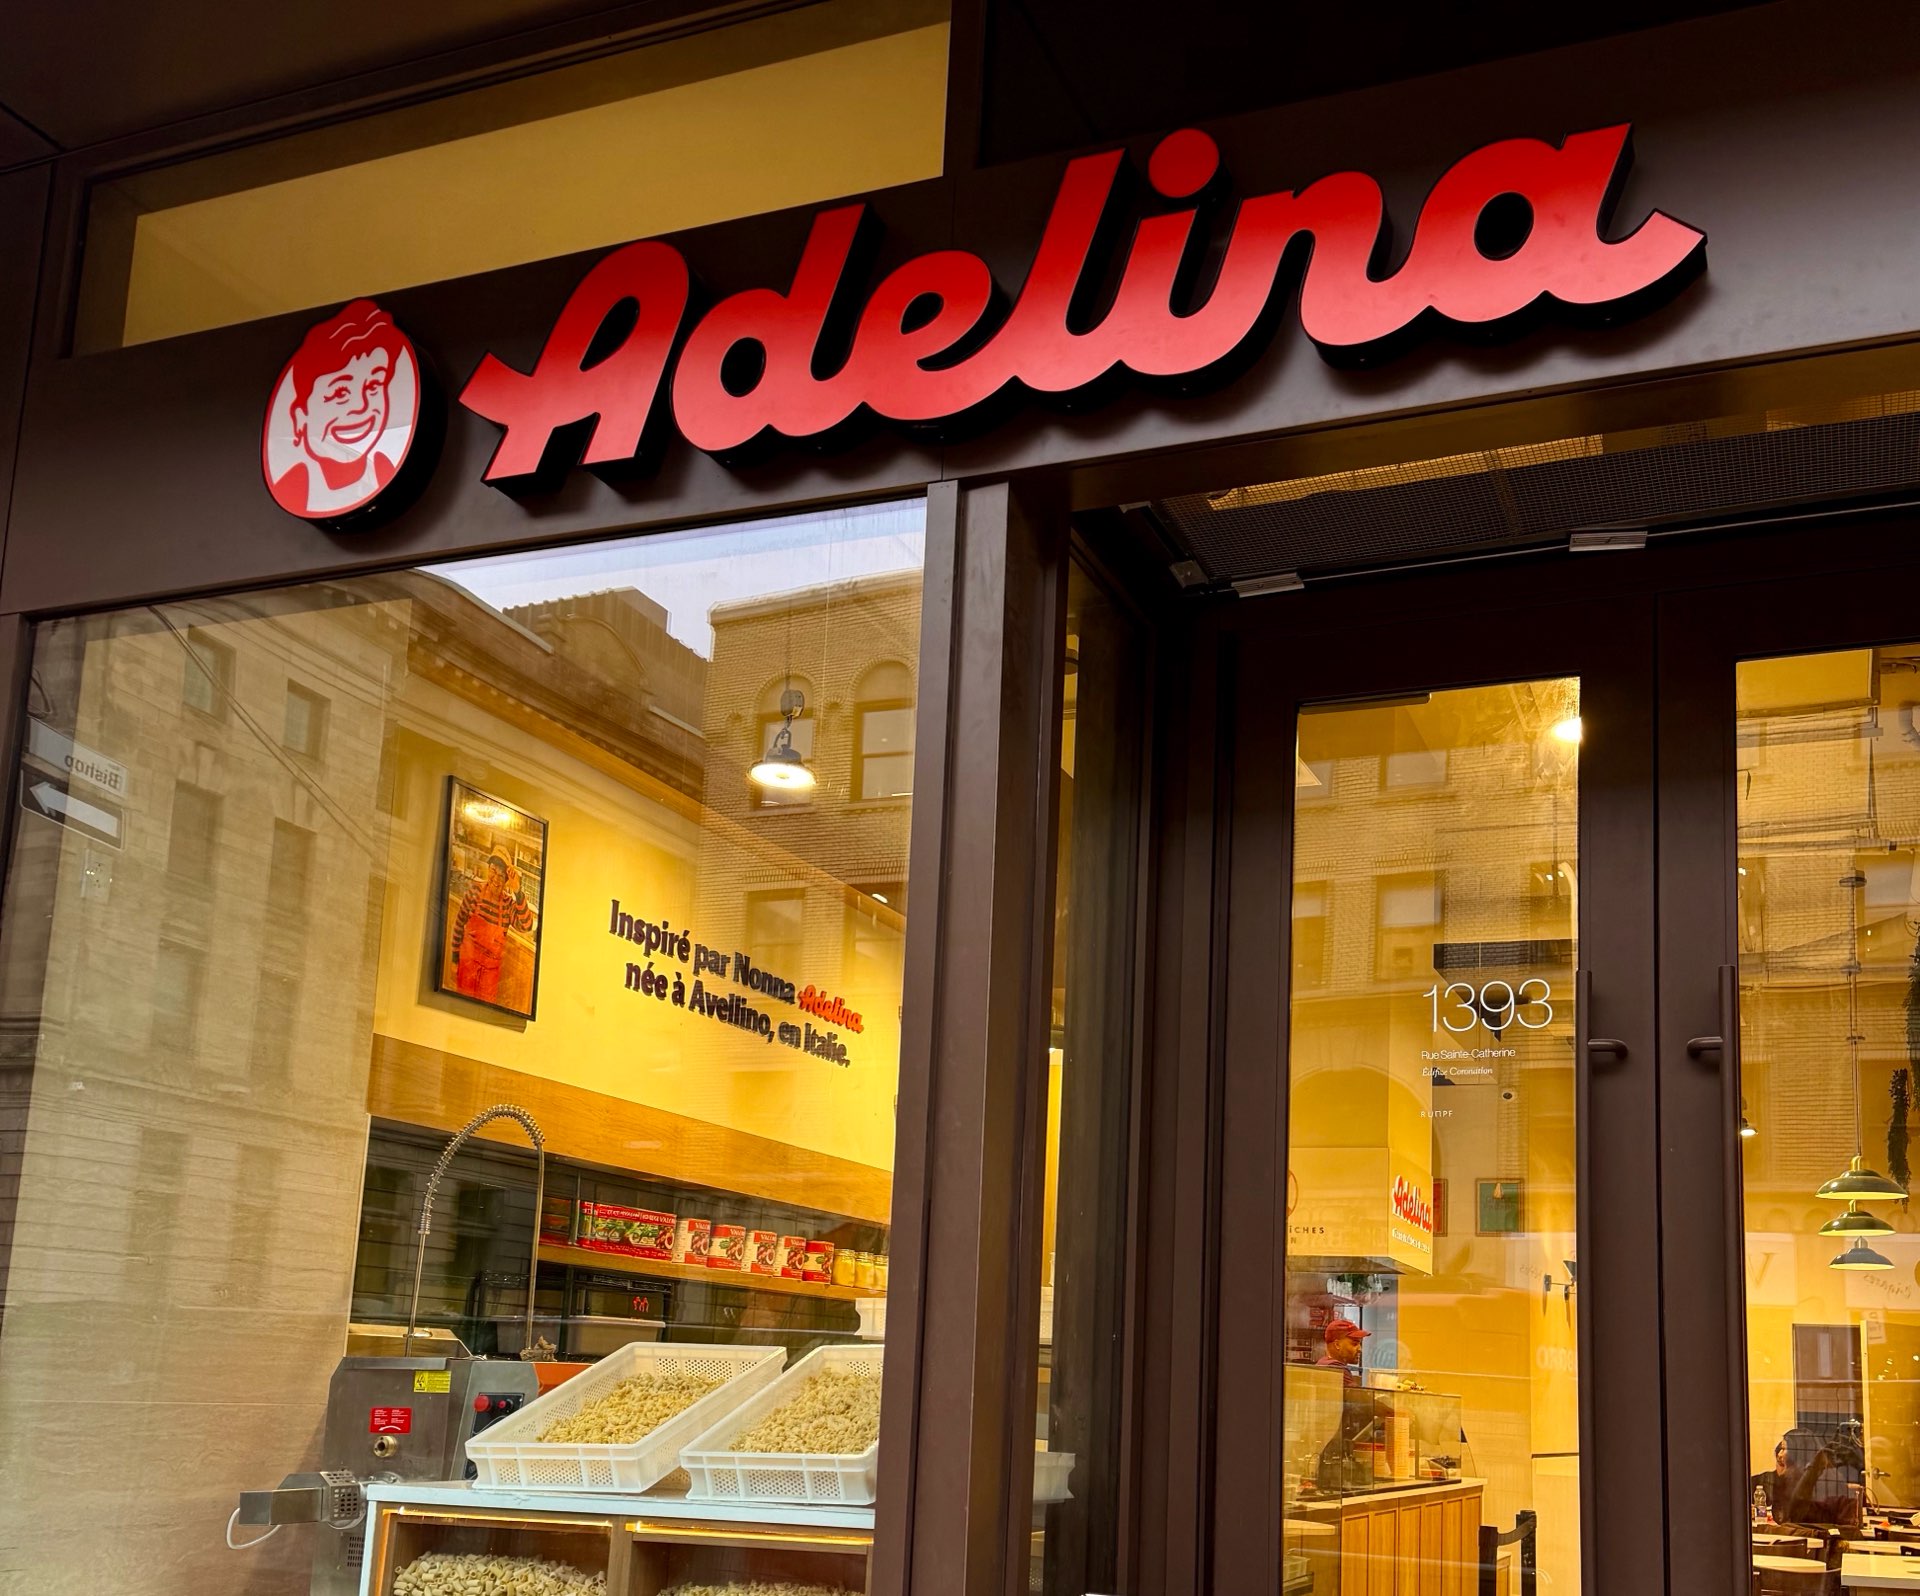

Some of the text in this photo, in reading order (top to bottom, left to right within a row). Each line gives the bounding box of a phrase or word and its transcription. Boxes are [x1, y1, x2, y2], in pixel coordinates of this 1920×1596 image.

[459, 122, 1707, 484] Adelina
[609, 899, 864, 1033] Inspiré par Nonna Adelina
[624, 961, 668, 1000] née
[671, 972, 685, 1008] à
[689, 980, 775, 1044] Avellino,
[778, 1021, 801, 1049] en
[1423, 978, 1553, 1032] 1393
[1421, 1048, 1516, 1060] Rue Sainte-Catherine
[1450, 1066, 1493, 1076] Coronation
[1392, 1174, 1432, 1233] Adelina
